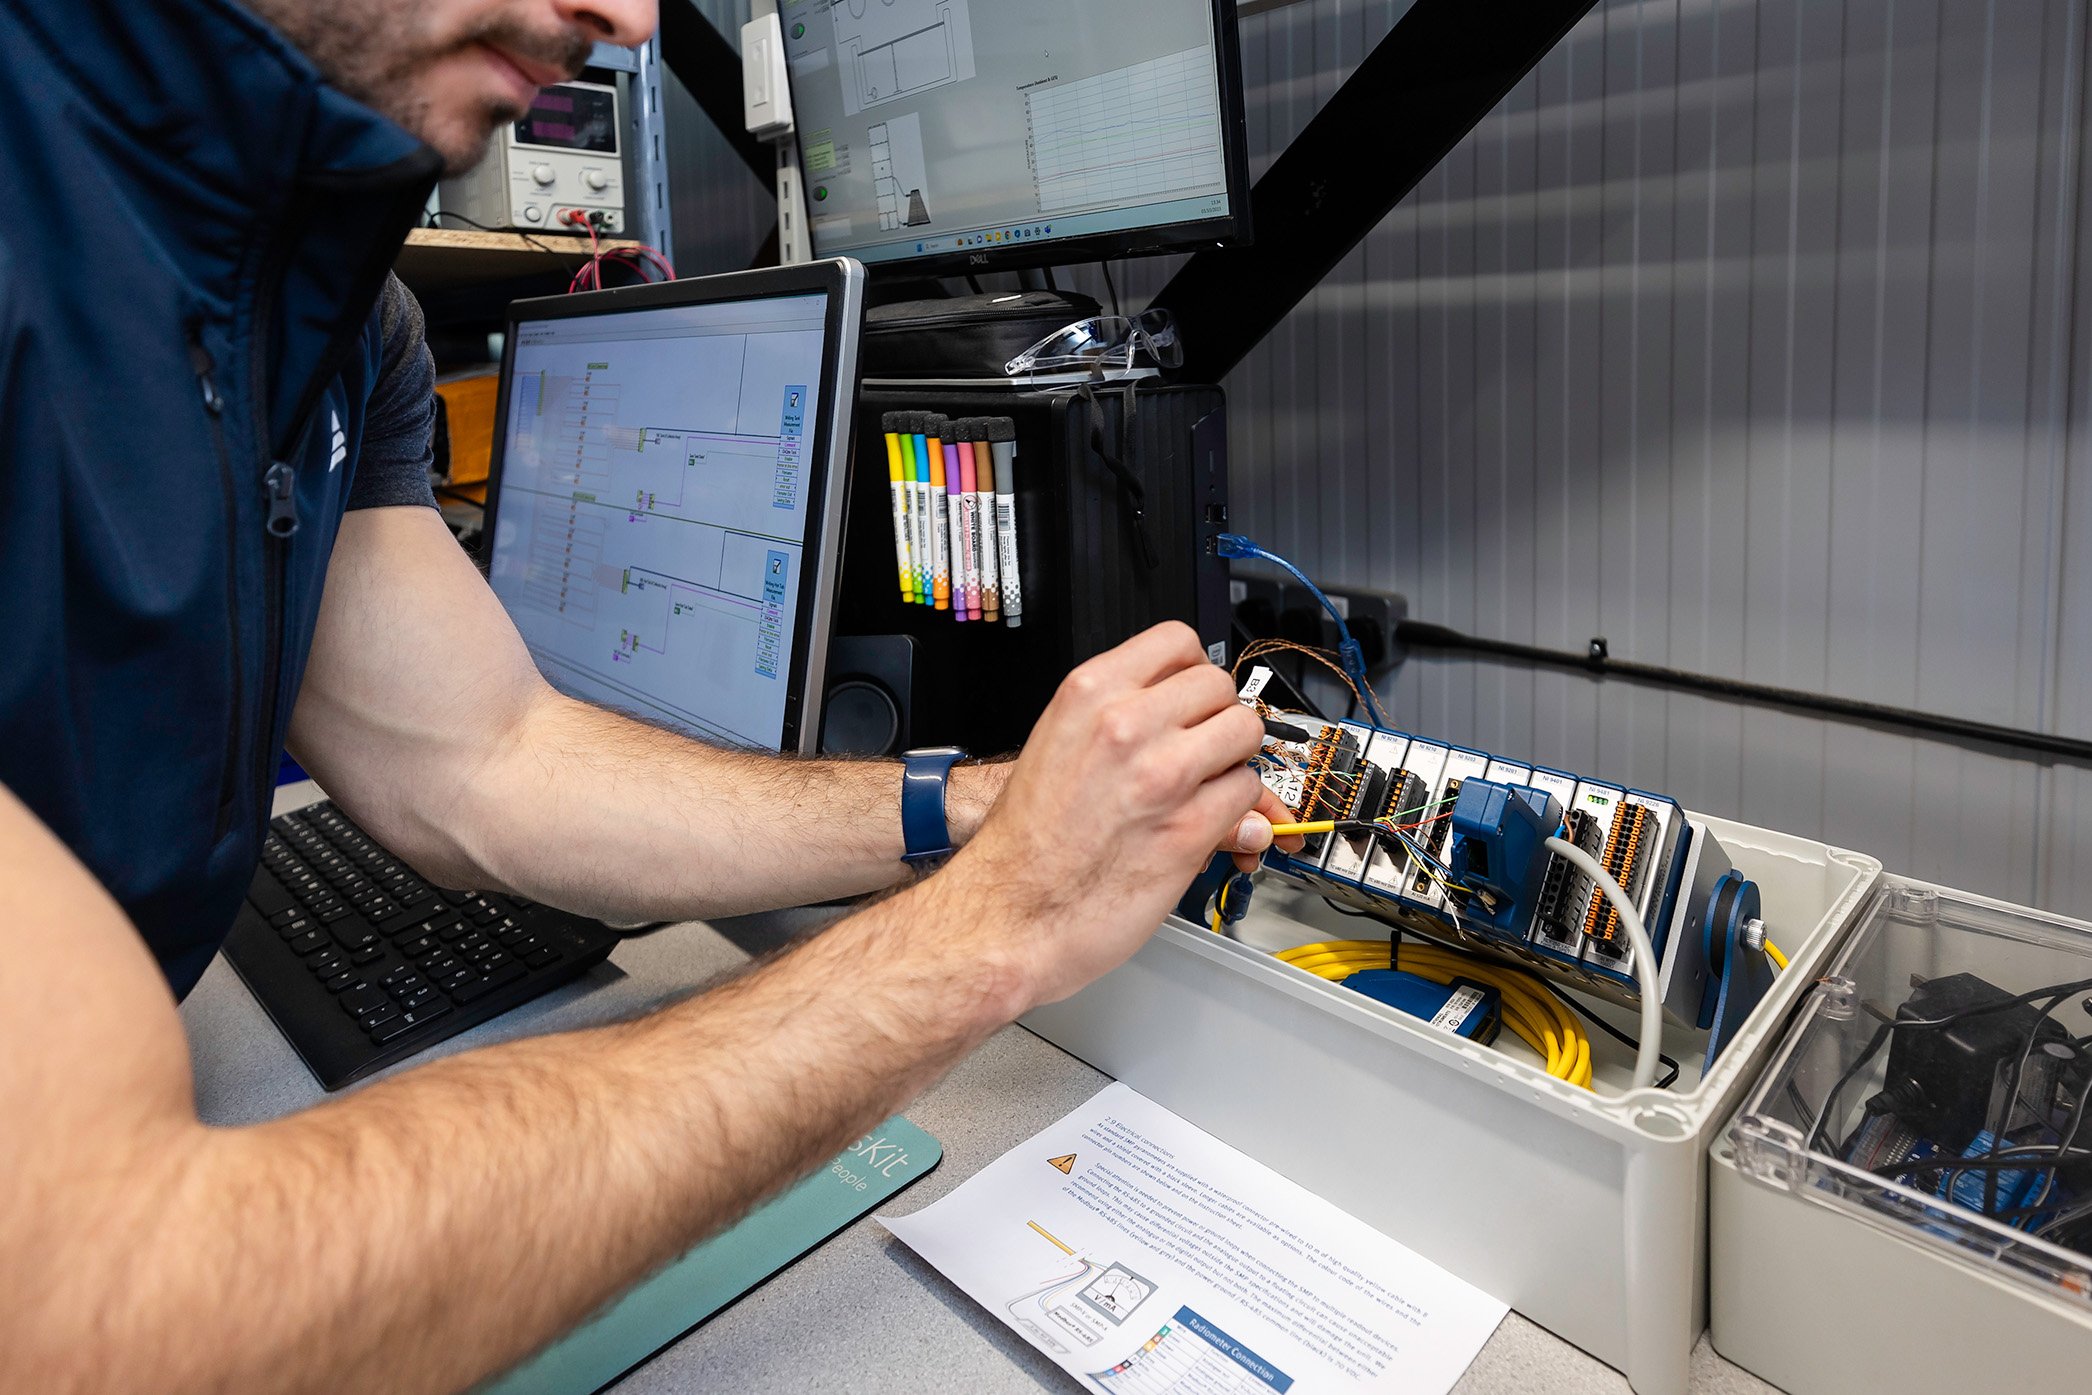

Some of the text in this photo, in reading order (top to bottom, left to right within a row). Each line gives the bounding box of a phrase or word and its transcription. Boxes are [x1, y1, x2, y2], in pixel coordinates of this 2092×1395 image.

[970, 254, 988, 265] DELL
[1089, 1127, 1102, 1137] wires
[1130, 1151, 1151, 1165] covered
[1149, 1163, 1163, 1173] with
[1166, 1172, 1181, 1183] black
[1180, 1181, 1199, 1194] sleeve.
[1197, 1191, 1217, 1205] Longer
[1216, 1201, 1235, 1214] cables
[1245, 1218, 1272, 1235] available
[1102, 1124, 1124, 1140] standard
[1132, 1142, 1167, 1165] pyranometers
[1173, 1167, 1198, 1183] supplied
[1196, 1179, 1210, 1189] with
[1211, 1188, 1243, 1208] waterproof
[1240, 1203, 1269, 1223] connector
[1114, 1121, 1142, 1140] Electrical
[1140, 1136, 1175, 1160] connections
[1070, 1180, 1099, 1200] recommend
[1096, 1197, 1112, 1210] using
[1134, 1222, 1159, 1240] analogue
[1173, 1245, 1194, 1260] digital
[1191, 1256, 1213, 1272] output
[1077, 1174, 1097, 1189] ground
[1094, 1185, 1111, 1198] loops.
[1111, 1195, 1123, 1205] This
[1133, 1210, 1149, 1222] cause
[1148, 1219, 1179, 1239] differential
[1176, 1236, 1201, 1253] voltages
[1200, 1249, 1224, 1265] outside
[1085, 1167, 1114, 1188] Connecting
[1121, 1190, 1140, 1204] RS-485
[1149, 1207, 1175, 1226] grounded
[1173, 1222, 1193, 1235] circuit
[1211, 1244, 1240, 1264] analogue
[1093, 1161, 1113, 1177] Special
[1111, 1172, 1134, 1189] attention
[1137, 1188, 1158, 1203] needed
[1161, 1203, 1183, 1219] prevent
[1180, 1216, 1198, 1228] power
[1203, 1227, 1225, 1243] ground
[1222, 1239, 1241, 1253] loops
[1239, 1249, 1256, 1262] when
[1111, 1151, 1132, 1165] numbers
[1140, 1168, 1157, 1180] shown
[1156, 1177, 1172, 1189] below
[1197, 1201, 1227, 1220] instruction
[1225, 1217, 1244, 1229] sheet.
[1097, 1209, 1118, 1224] RS-485
[1116, 1221, 1131, 1233] lines
[1128, 1230, 1150, 1246] (yellow
[1194, 1271, 1214, 1285] power
[1212, 1282, 1236, 1299] ground
[1188, 1318, 1275, 1382] Radiometer Connection
